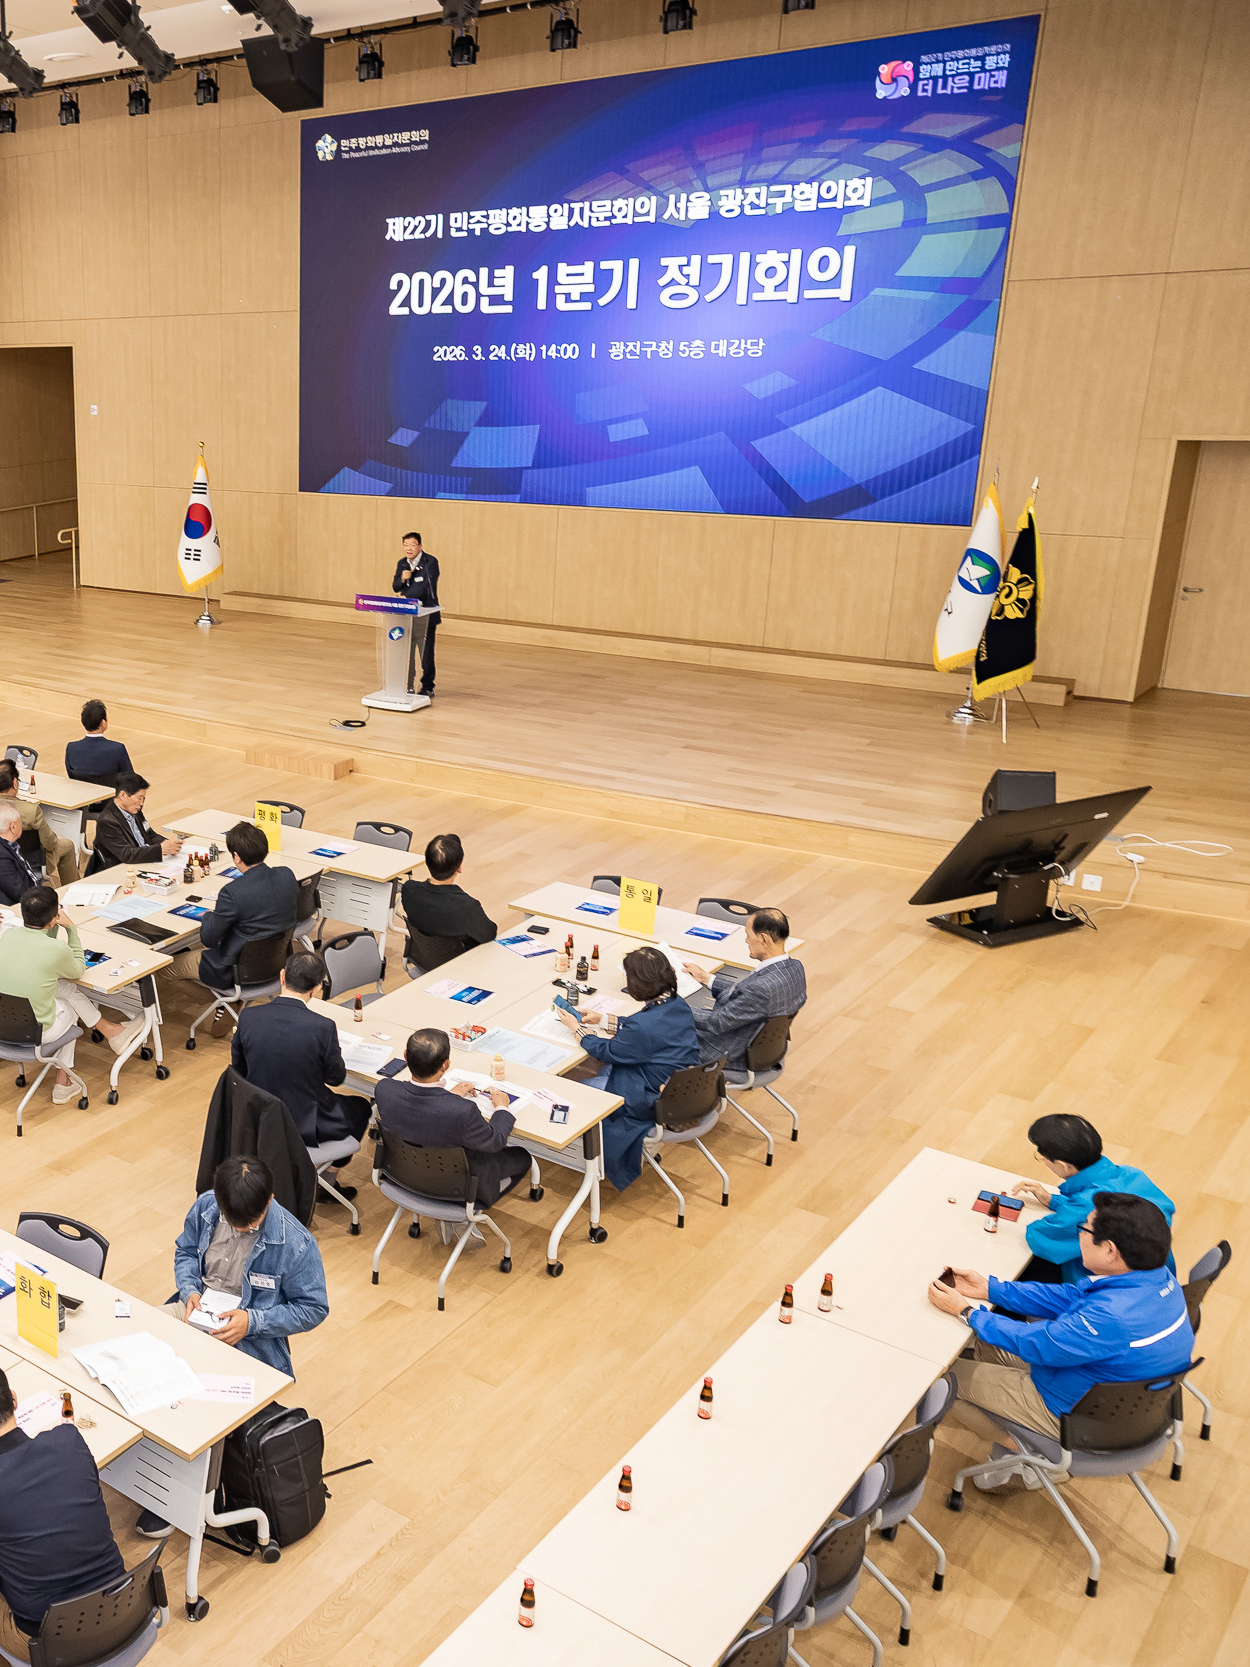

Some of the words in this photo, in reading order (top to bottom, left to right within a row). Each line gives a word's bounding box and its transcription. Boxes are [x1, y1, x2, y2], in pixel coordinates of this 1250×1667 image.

[919, 63, 943, 78] 함께
[945, 58, 982, 74] 만드는
[984, 54, 1010, 70] 평화
[917, 80, 933, 97] 더
[936, 74, 970, 95] 나은
[973, 70, 1008, 90] 미래
[340, 129, 430, 151] 민주평화통일자문회의
[385, 216, 444, 242] 제22기
[450, 195, 657, 238] 민주평화통일자문회의
[662, 191, 711, 222] 서울
[717, 177, 873, 219] 광진구협의회
[388, 265, 515, 316] 2026년
[532, 258, 640, 311] 1분기
[656, 245, 857, 309] 정기회의
[432, 344, 470, 362] 2026.
[472, 345, 486, 361] 3.
[540, 342, 579, 360] 14:00
[608, 340, 674, 361] 광진구청
[678, 340, 706, 359] 5층
[710, 337, 766, 359] 대강당
